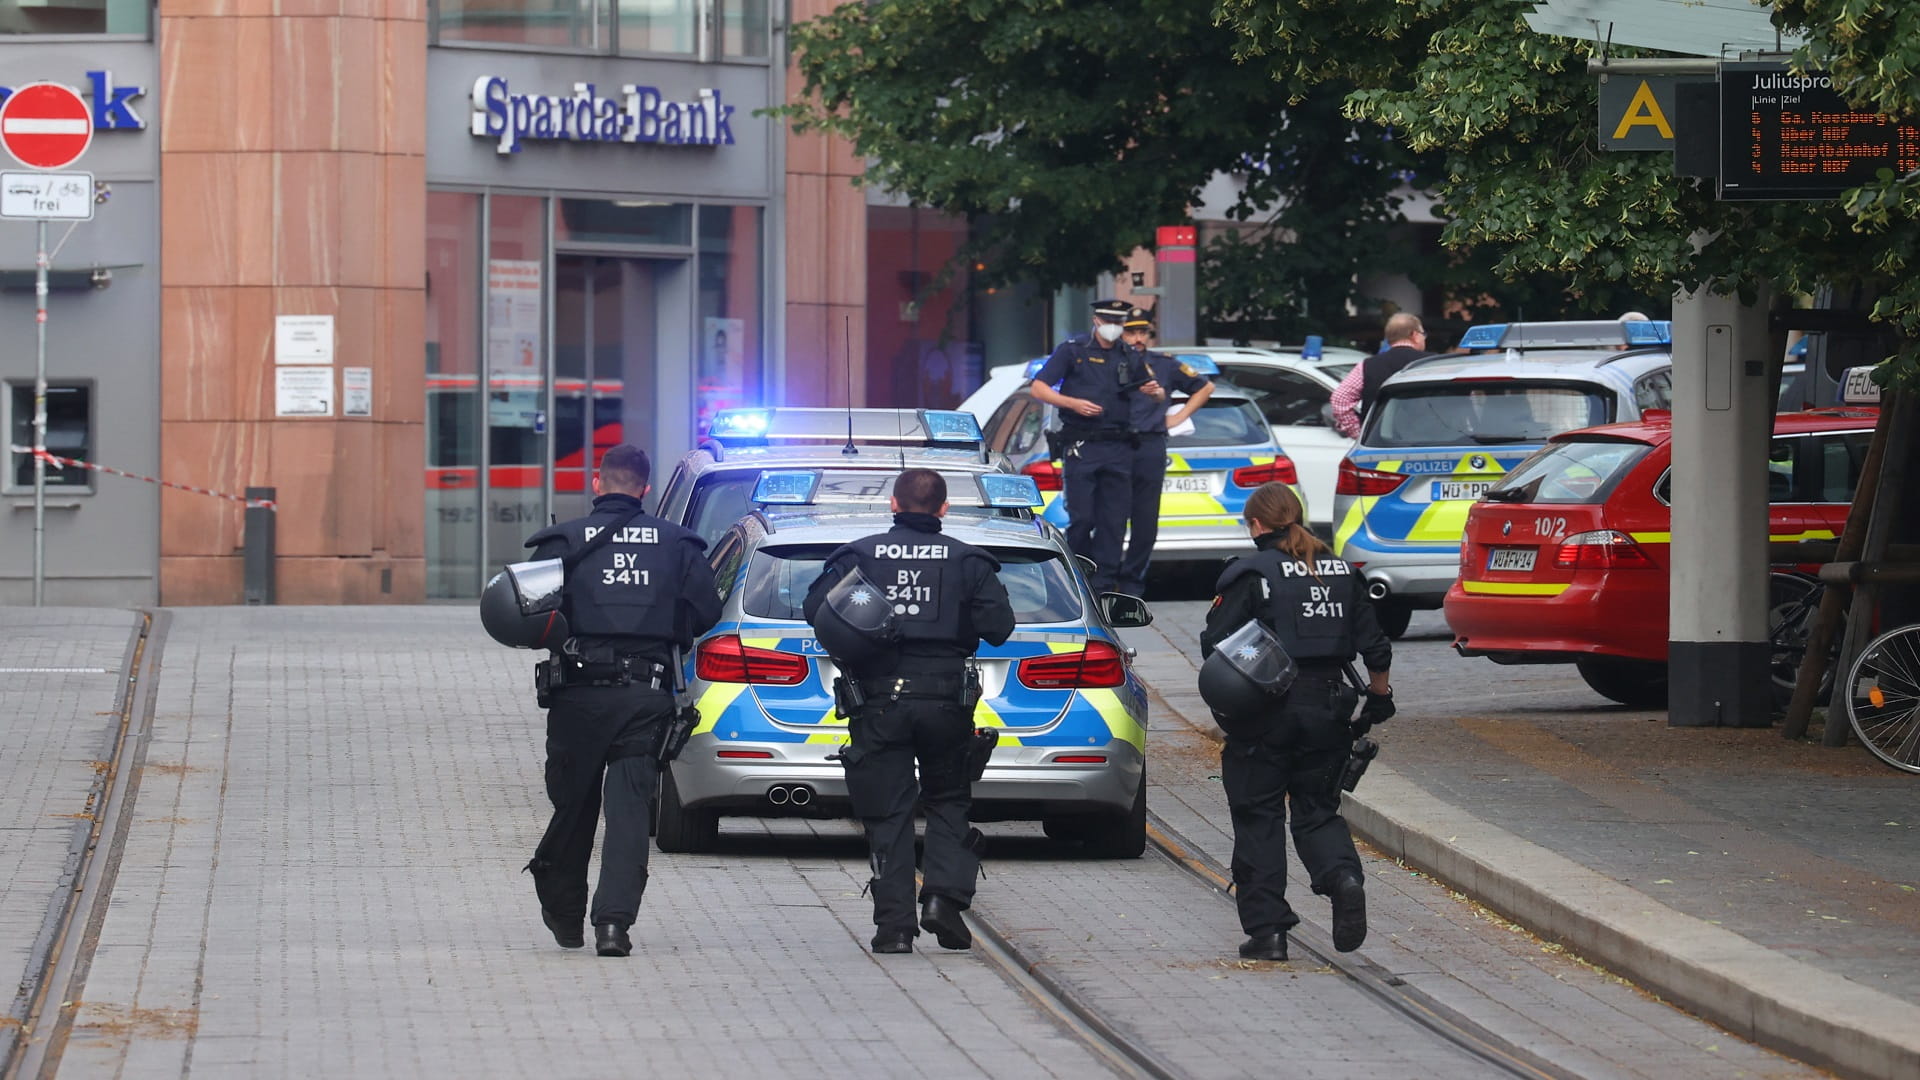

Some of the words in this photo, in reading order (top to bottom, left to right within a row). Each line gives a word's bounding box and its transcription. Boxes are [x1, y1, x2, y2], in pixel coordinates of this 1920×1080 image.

[1752, 73, 1834, 92] Juliuspro
[1754, 95, 1777, 104] Linie
[1783, 95, 1801, 104] Ziel
[471, 75, 735, 153] Sparda-Bank
[1612, 79, 1675, 139] A
[33, 198, 59, 211] frei
[1846, 372, 1880, 396] FEUE
[1405, 461, 1453, 473] POLIZEI
[1176, 479, 1208, 491] 4013
[1442, 483, 1460, 498] WÜ
[584, 526, 659, 544] PLIZEI
[1534, 517, 1567, 537] 10/2
[613, 552, 638, 568] BY
[874, 544, 949, 560] POLIZEI
[602, 569, 649, 585] 3411
[897, 569, 922, 585] BY
[885, 585, 931, 602] 3411
[1310, 586, 1330, 601] BY
[1302, 602, 1343, 617] 3411
